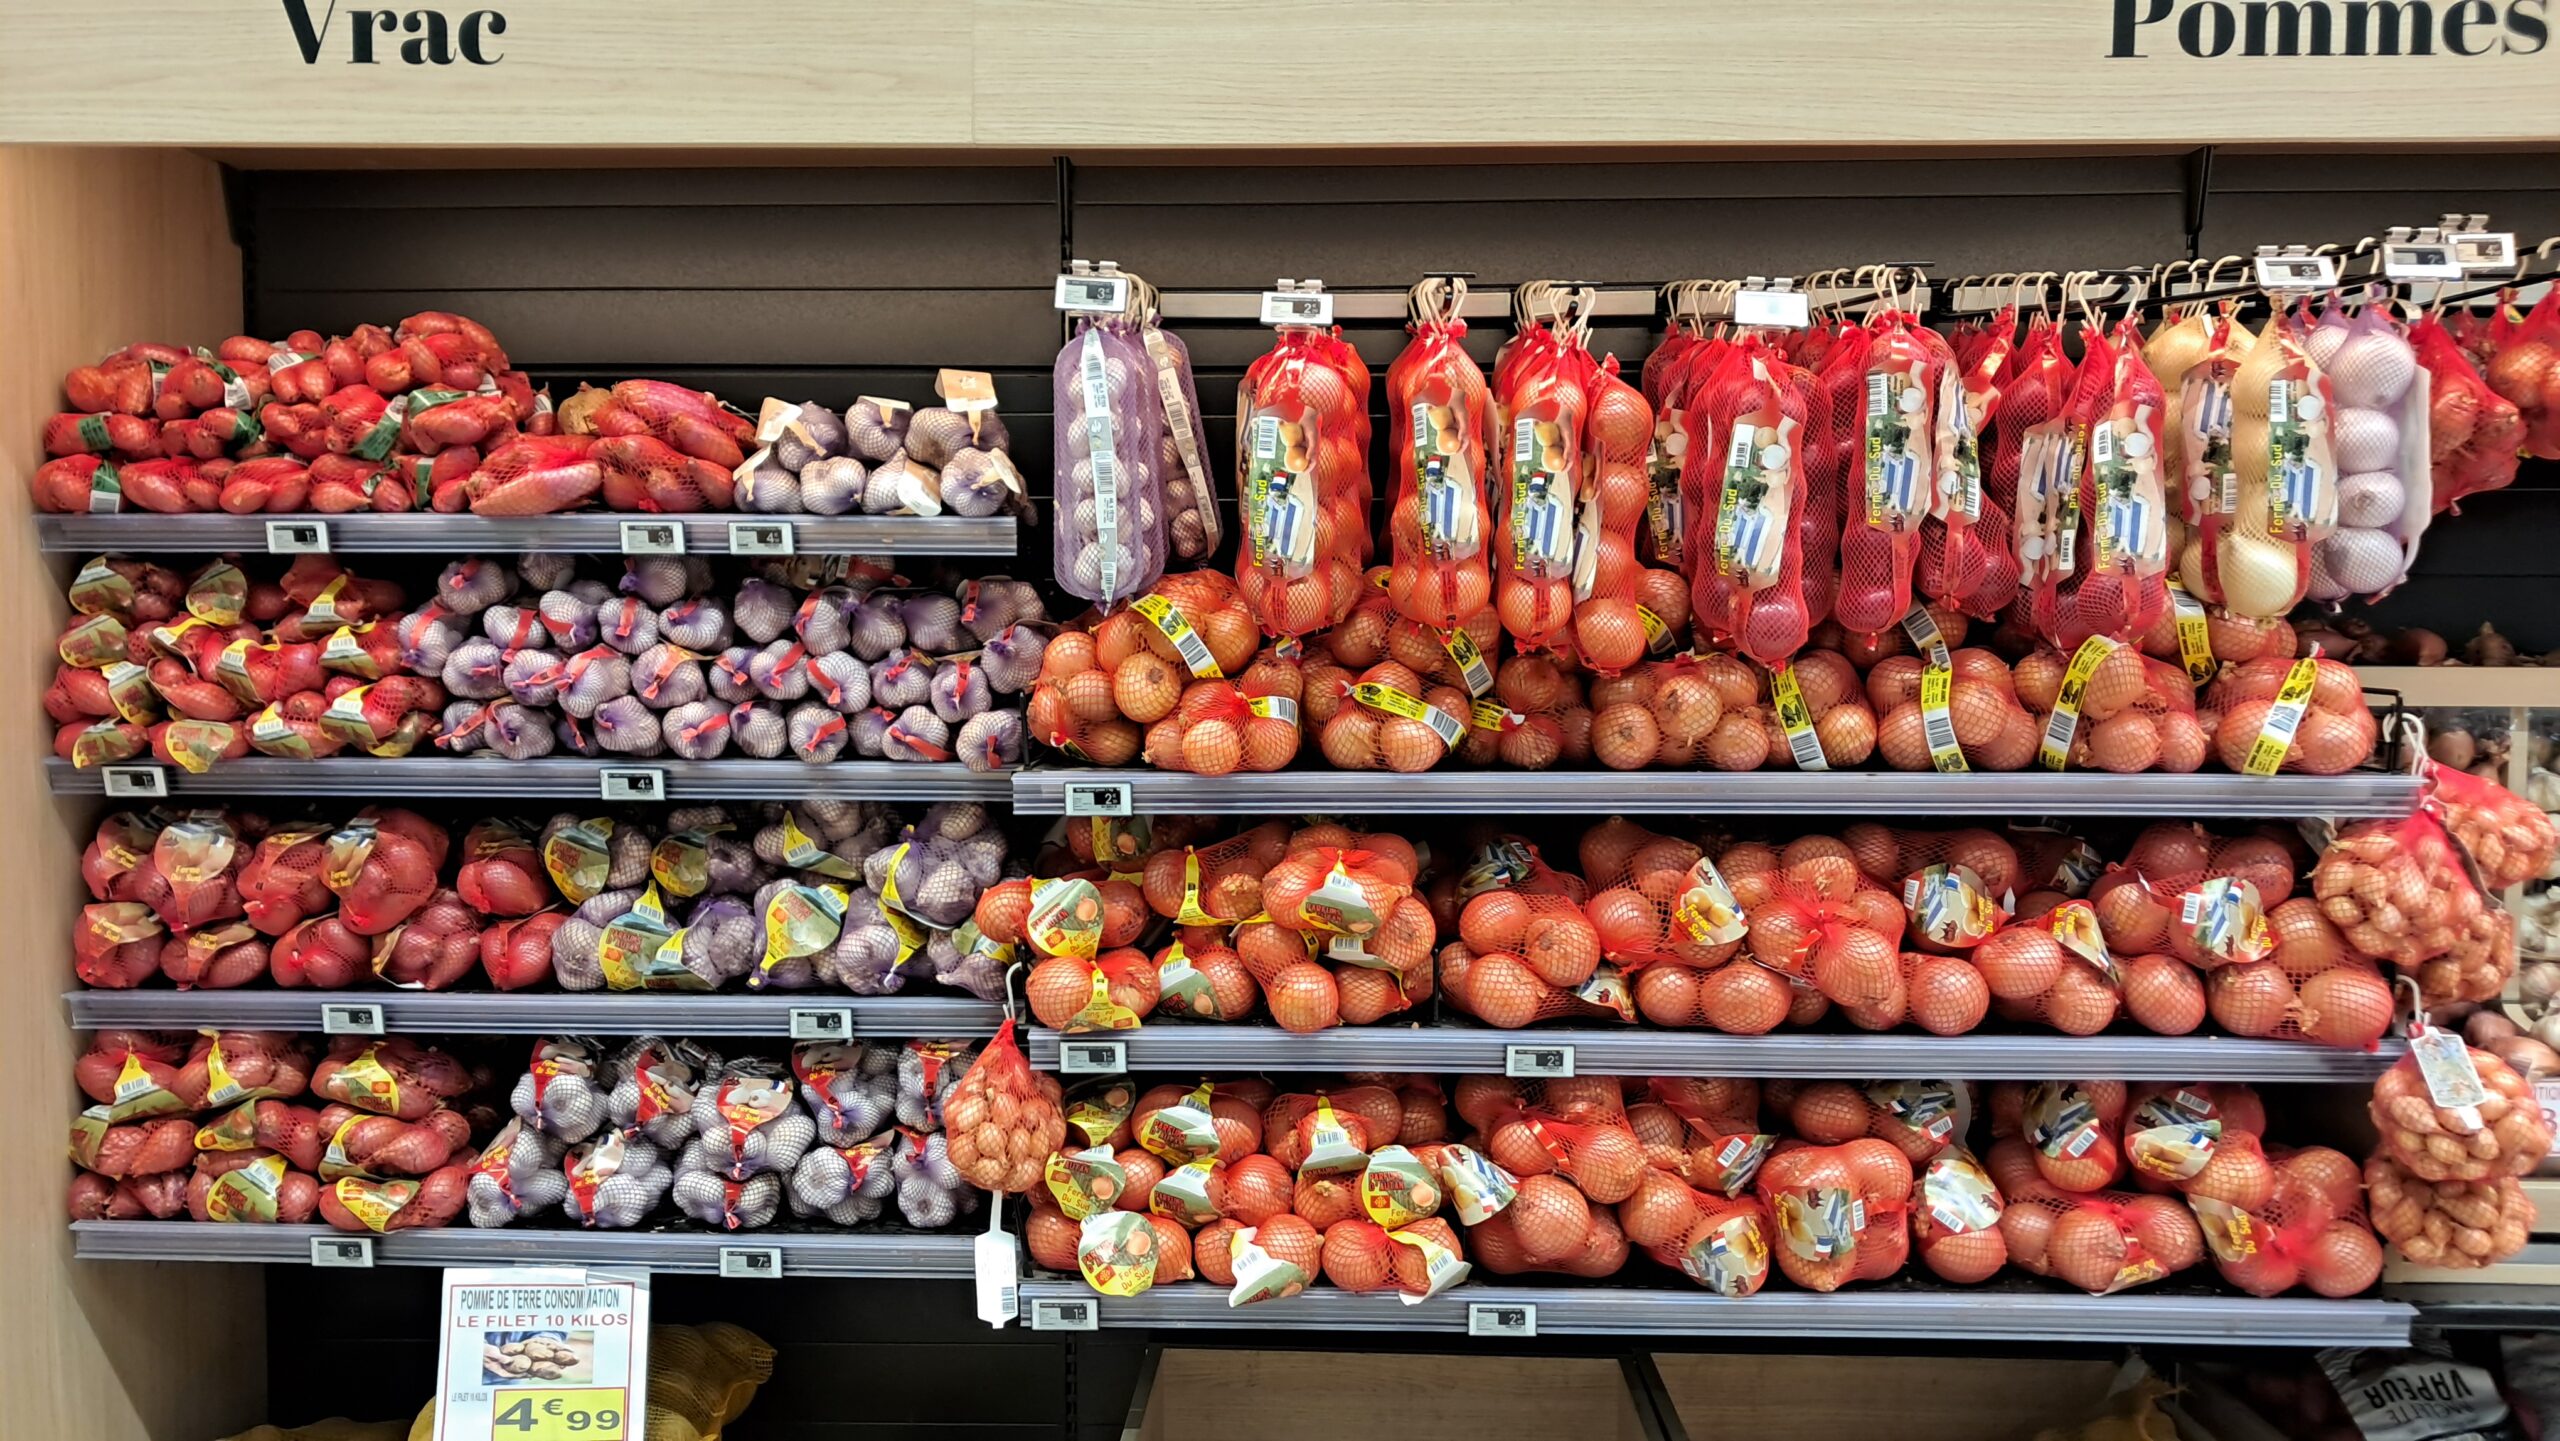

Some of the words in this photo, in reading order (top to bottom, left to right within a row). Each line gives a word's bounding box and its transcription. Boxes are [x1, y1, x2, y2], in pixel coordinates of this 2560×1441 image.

[281, 0, 507, 65] Vrac
[2104, 0, 2549, 57] Pommes
[1869, 437, 1881, 459] Sud
[2271, 444, 2282, 467] Sud
[1869, 466, 1881, 481] Du
[2270, 474, 2282, 489] Du
[1254, 479, 1267, 501] Sud
[1515, 482, 1526, 504] Sud
[1723, 488, 1737, 511] Sud
[1254, 508, 1265, 524] Du
[1514, 511, 1525, 526] Du
[1719, 518, 1731, 533] Du
[1675, 908, 1688, 923] Du
[1688, 923, 1706, 942] Sud
[1134, 1268, 1150, 1281] Sud
[461, 1290, 494, 1310] POMME
[497, 1290, 509, 1309] DE
[512, 1289, 541, 1309] TERRE
[457, 1316, 478, 1327] LE
[487, 1315, 538, 1327] FILET
[546, 1315, 564, 1327] 10
[571, 1313, 628, 1326] KILOS
[2363, 1369, 2473, 1409] VAPEUR
